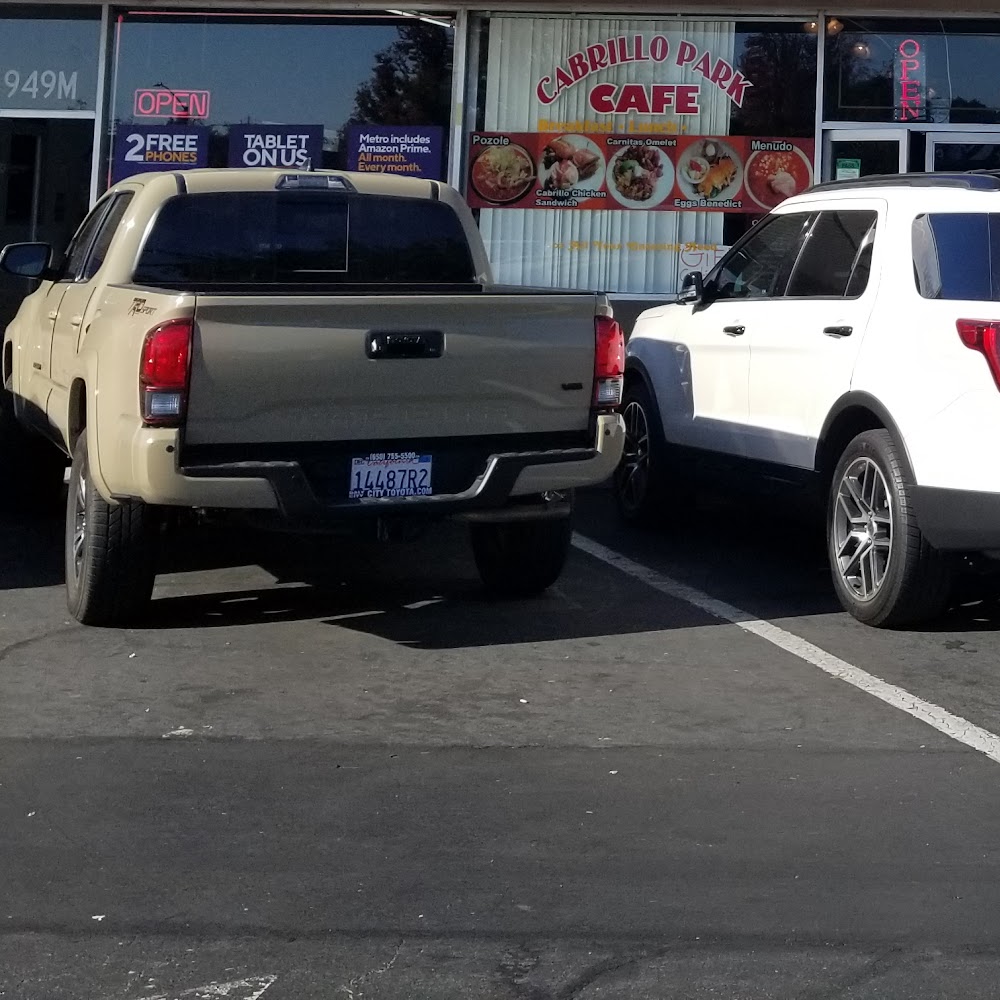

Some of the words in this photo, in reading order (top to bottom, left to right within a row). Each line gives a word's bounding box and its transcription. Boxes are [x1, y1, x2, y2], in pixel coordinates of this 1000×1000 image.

[536, 34, 669, 106] CABRILLO
[676, 39, 754, 108] PARK
[4, 69, 78, 101] 949M
[899, 38, 921, 122] OPEN
[138, 91, 207, 116] OPEN
[589, 83, 701, 115] CAFE
[146, 134, 199, 152] FREE
[244, 134, 309, 149] TABLET
[359, 133, 390, 144] Metro
[390, 133, 431, 144] includes
[472, 135, 510, 146] Pozole
[606, 138, 643, 147] Carnitas
[645, 138, 678, 147] Omelet
[124, 133, 145, 162] 2
[358, 143, 399, 153] Amazon
[400, 143, 431, 154] Prime.
[751, 141, 794, 152] Menudo
[145, 151, 198, 163] PHONES
[243, 148, 278, 167] ON
[281, 149, 309, 167] US
[358, 153, 372, 162] All
[373, 153, 407, 162] month.
[358, 162, 386, 173] Every
[387, 162, 421, 172] month.
[535, 189, 572, 198] Cabrillo
[572, 189, 607, 198] Chicken
[535, 198, 579, 207] Sandwich
[674, 198, 698, 208] Eggs
[699, 199, 743, 209] Benedict
[681, 246, 725, 267] GIF
[355, 468, 428, 491] 14487R2
[367, 489, 384, 498] CITY
